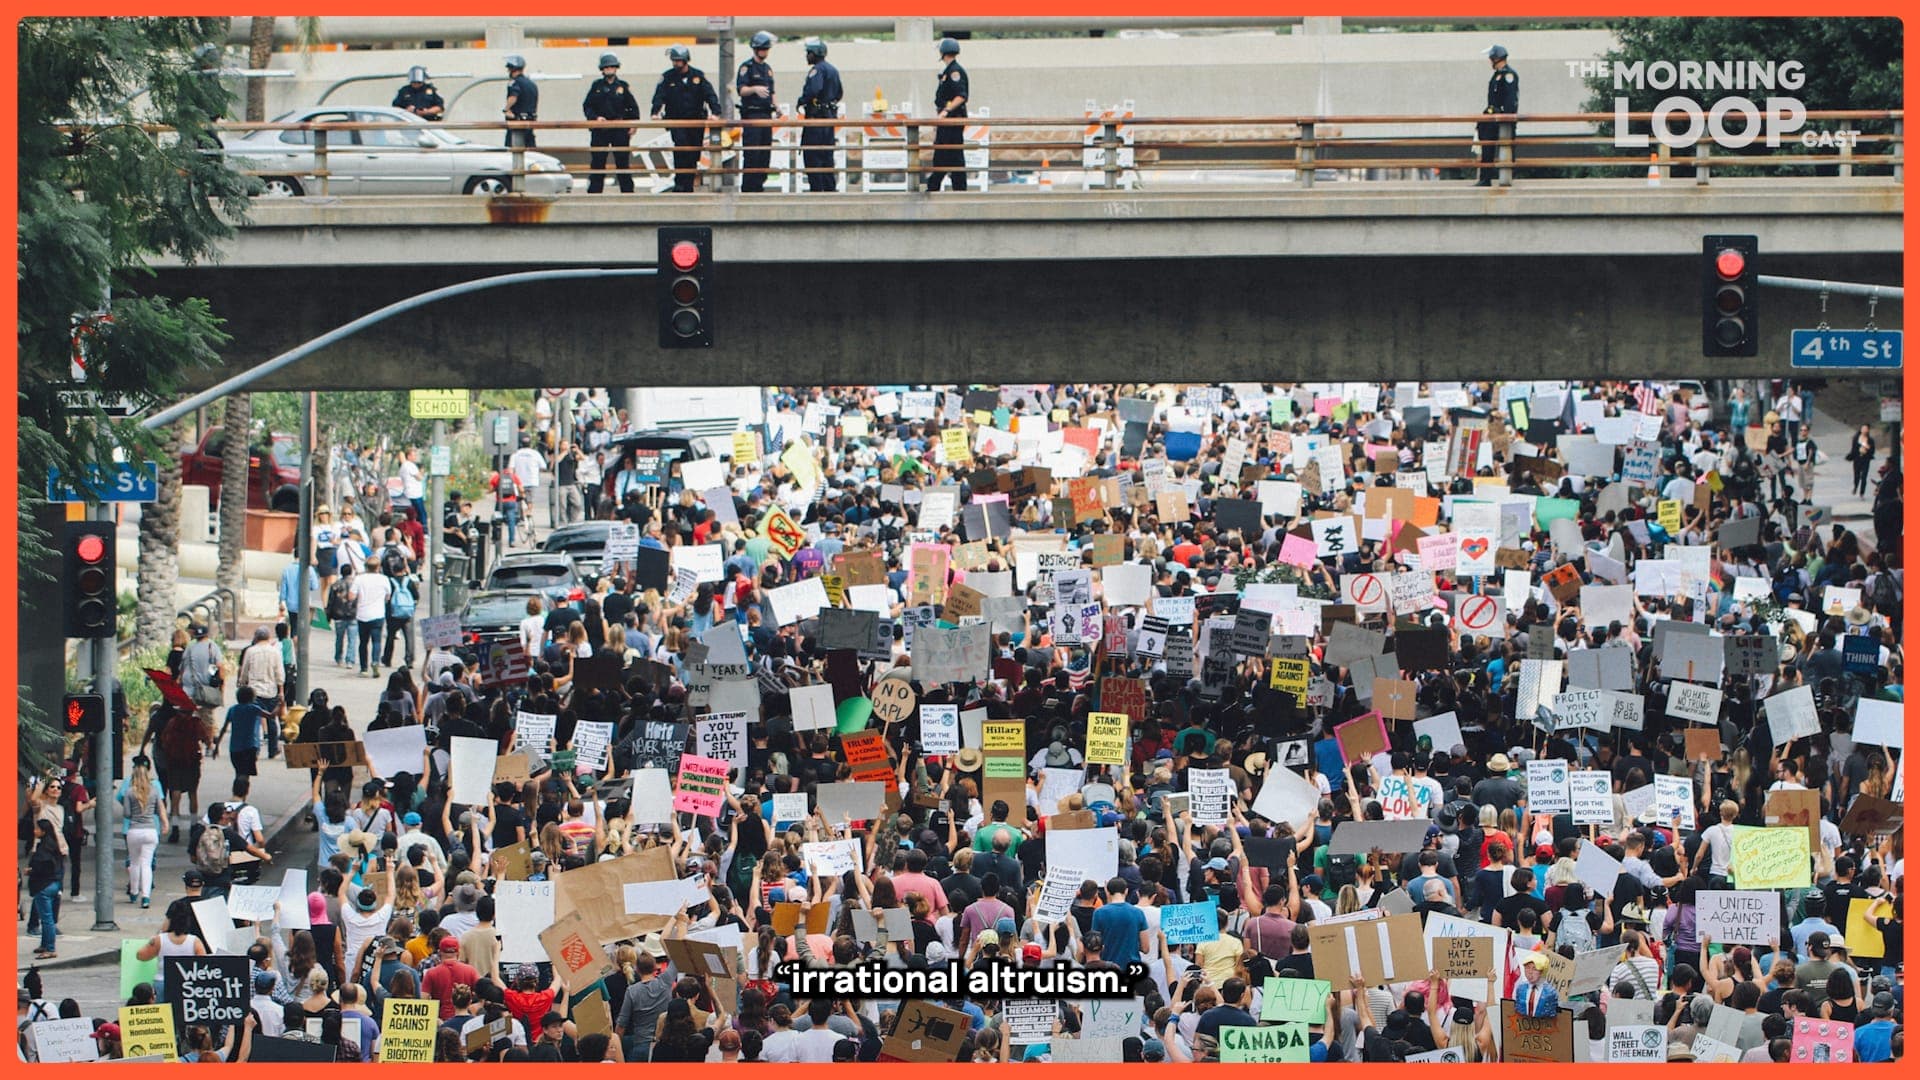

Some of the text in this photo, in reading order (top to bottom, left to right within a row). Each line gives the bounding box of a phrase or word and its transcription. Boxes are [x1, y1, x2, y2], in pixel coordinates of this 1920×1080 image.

[1800, 337, 1893, 360] 4th St
[416, 401, 465, 414] SCHOOL
[117, 471, 147, 492] St
[1038, 554, 1080, 567] OBSTRUCT
[1846, 652, 1876, 664] THINK
[696, 664, 744, 675] 4 YEARS
[1278, 661, 1303, 670] STAND
[1276, 671, 1304, 681] AGAINST
[690, 684, 710, 693] PROT
[881, 684, 909, 699] NO
[1103, 679, 1141, 692] CIVIL
[1102, 693, 1144, 706] RIGHTS
[1555, 690, 1600, 704] PROTECT
[1681, 688, 1710, 700] NO HATE
[1677, 695, 1710, 710] NO TRUMP
[720, 711, 746, 719] TRUMP
[872, 698, 904, 721] DAPL
[1095, 716, 1121, 726] STAND
[1557, 710, 1599, 726] PUSSY
[1623, 710, 1639, 722] BAD
[709, 722, 734, 732] YOU
[986, 726, 1022, 735] Hillary
[1092, 726, 1121, 736] AGAINST
[703, 731, 740, 743] CAN'T
[847, 737, 875, 749] TRUMP
[711, 741, 733, 751] SIT
[1089, 740, 1125, 749] ANTI-MUSLIM
[1090, 748, 1121, 757] BIGOTRY!
[1382, 797, 1422, 817] LOV
[1719, 896, 1763, 910] UNITED
[1709, 911, 1765, 925] AGAINST
[1723, 927, 1758, 941] HATE
[1451, 938, 1471, 949] END
[1447, 949, 1475, 959] HATE
[175, 961, 223, 981] We've
[1444, 969, 1478, 977] TRUMP
[1549, 961, 1566, 974] UMP
[182, 977, 243, 998] Seen It
[1270, 981, 1330, 1012] ALLY
[183, 998, 243, 1022] Before
[393, 1003, 429, 1016] STAND
[1009, 1006, 1053, 1014] NEGAMOS
[389, 1018, 430, 1031] AGAINST
[1224, 1028, 1305, 1051] CANADA
[1612, 1031, 1634, 1040] WALL
[384, 1037, 432, 1048] ANTI-MUSLIM
[1521, 1035, 1553, 1051] ASS
[1612, 1040, 1639, 1049] STREET
[387, 1048, 427, 1060] BIGOTRY!
[1244, 1053, 1282, 1063] is too
[1612, 1050, 1619, 1058] IS
[1632, 1049, 1661, 1058] ENEMY.
